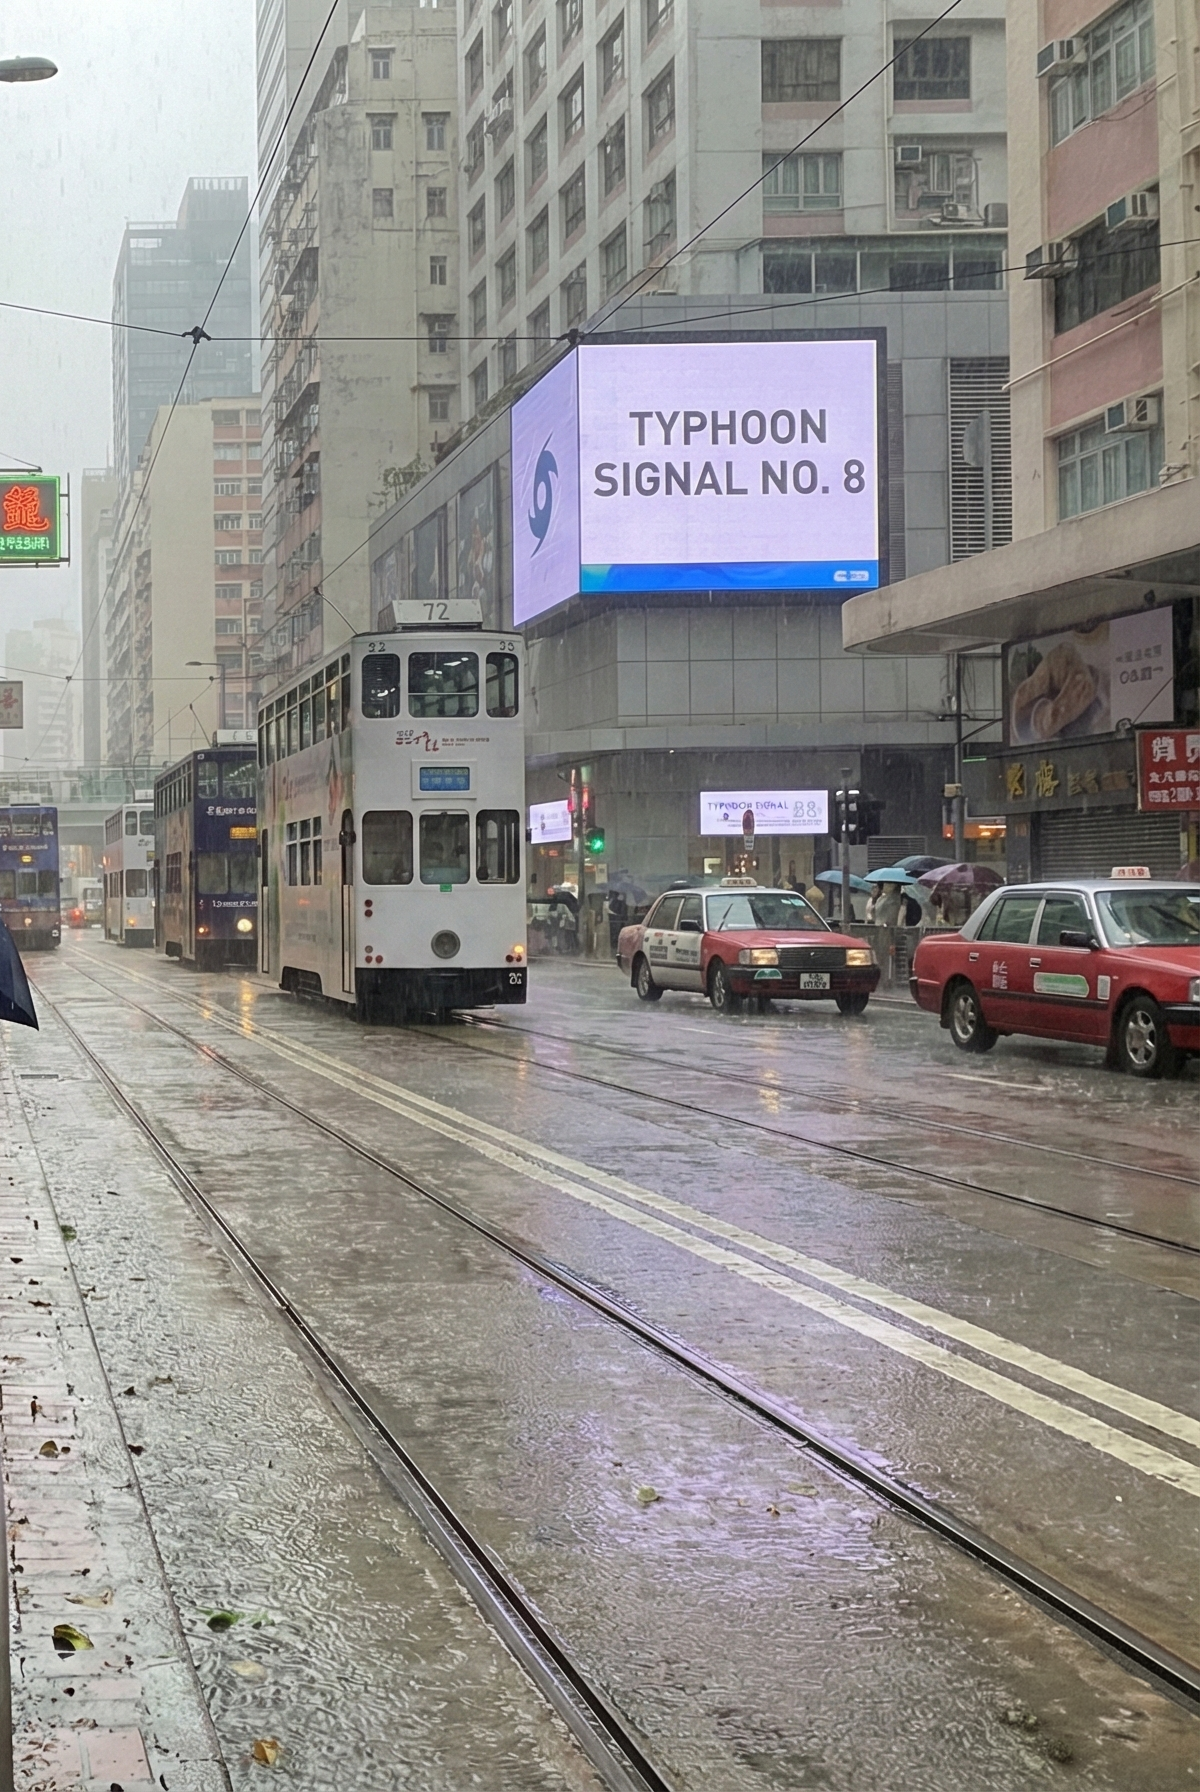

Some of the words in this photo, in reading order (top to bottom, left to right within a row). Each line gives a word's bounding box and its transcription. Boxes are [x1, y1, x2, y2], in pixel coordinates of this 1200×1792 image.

[629, 408, 827, 446] TYPHOON
[593, 460, 748, 497] SIGNAL
[761, 459, 830, 495] NO.
[843, 459, 866, 494] 8
[423, 602, 450, 621] 72
